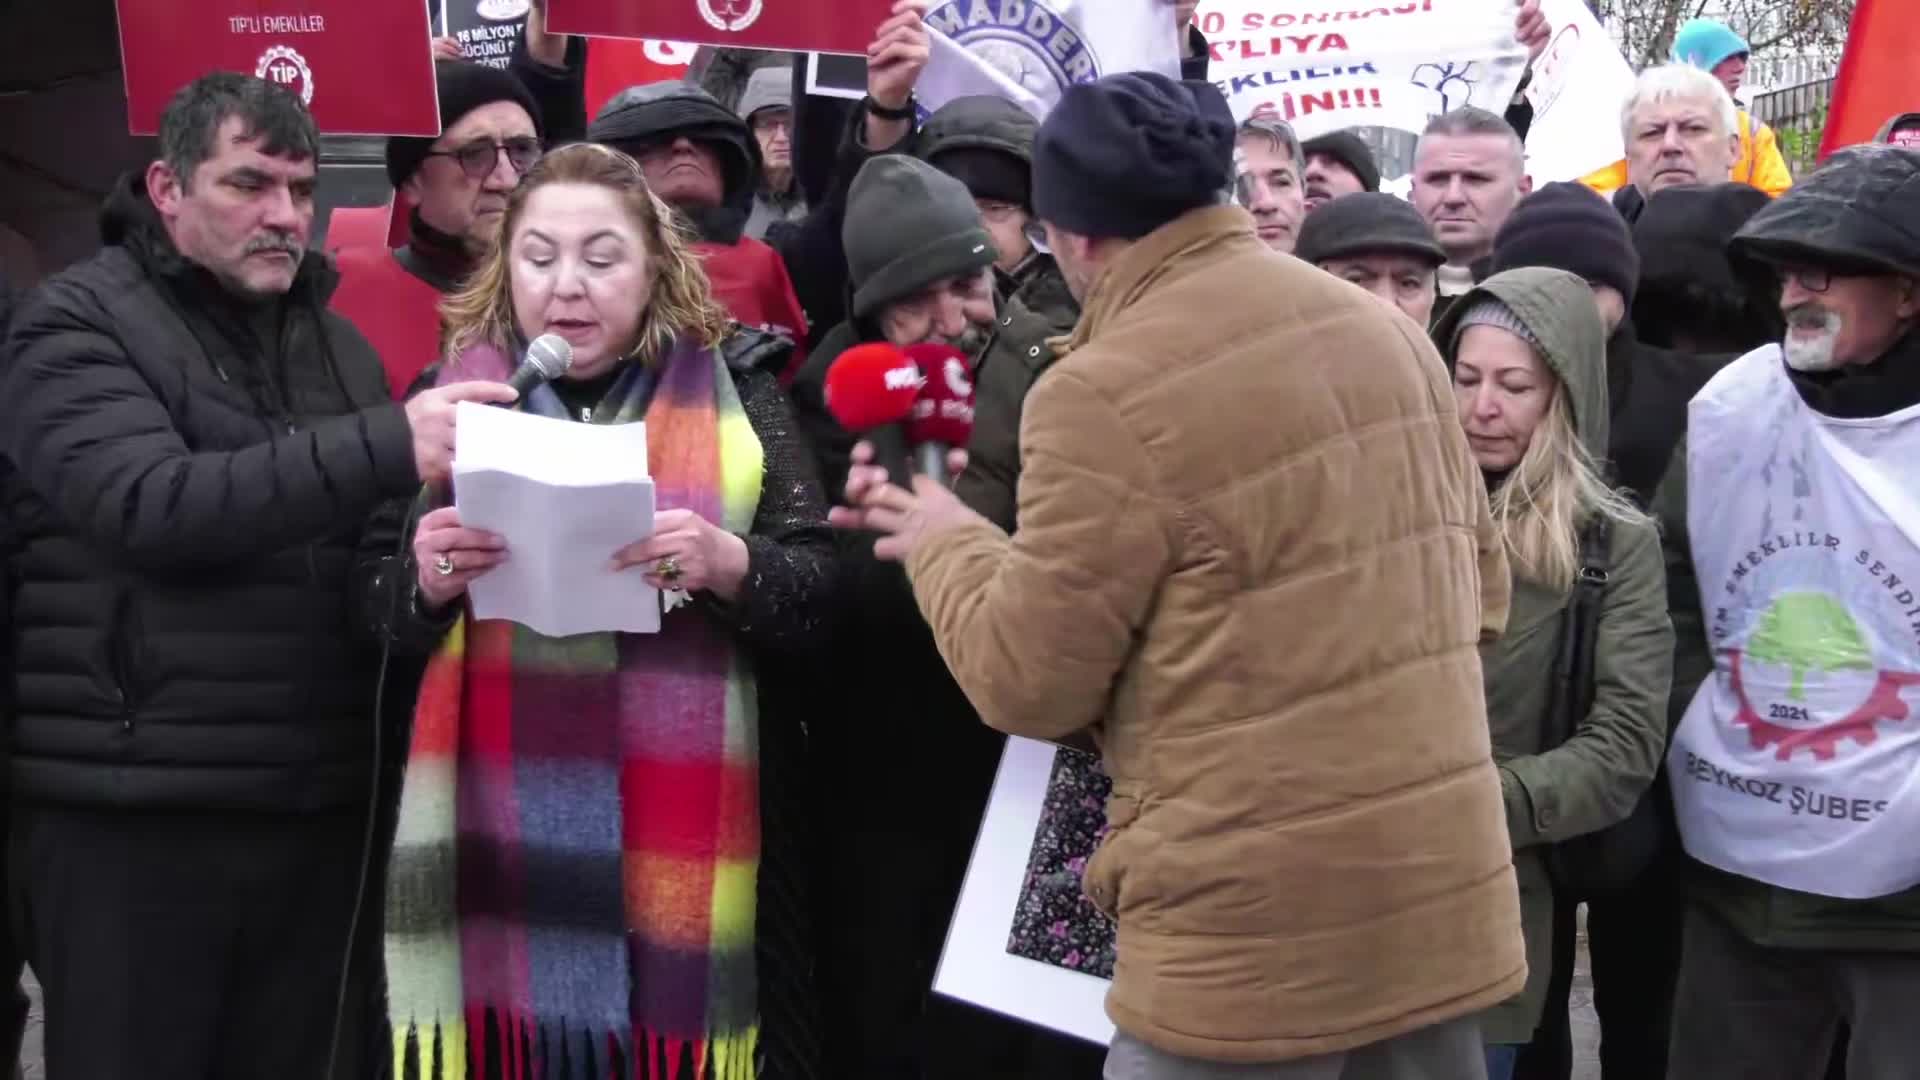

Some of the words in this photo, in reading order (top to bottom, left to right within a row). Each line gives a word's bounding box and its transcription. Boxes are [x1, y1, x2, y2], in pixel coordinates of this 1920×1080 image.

[461, 40, 506, 57] ÜCÜNÜ
[269, 62, 298, 83] TİP
[1769, 703, 1809, 721] 2021
